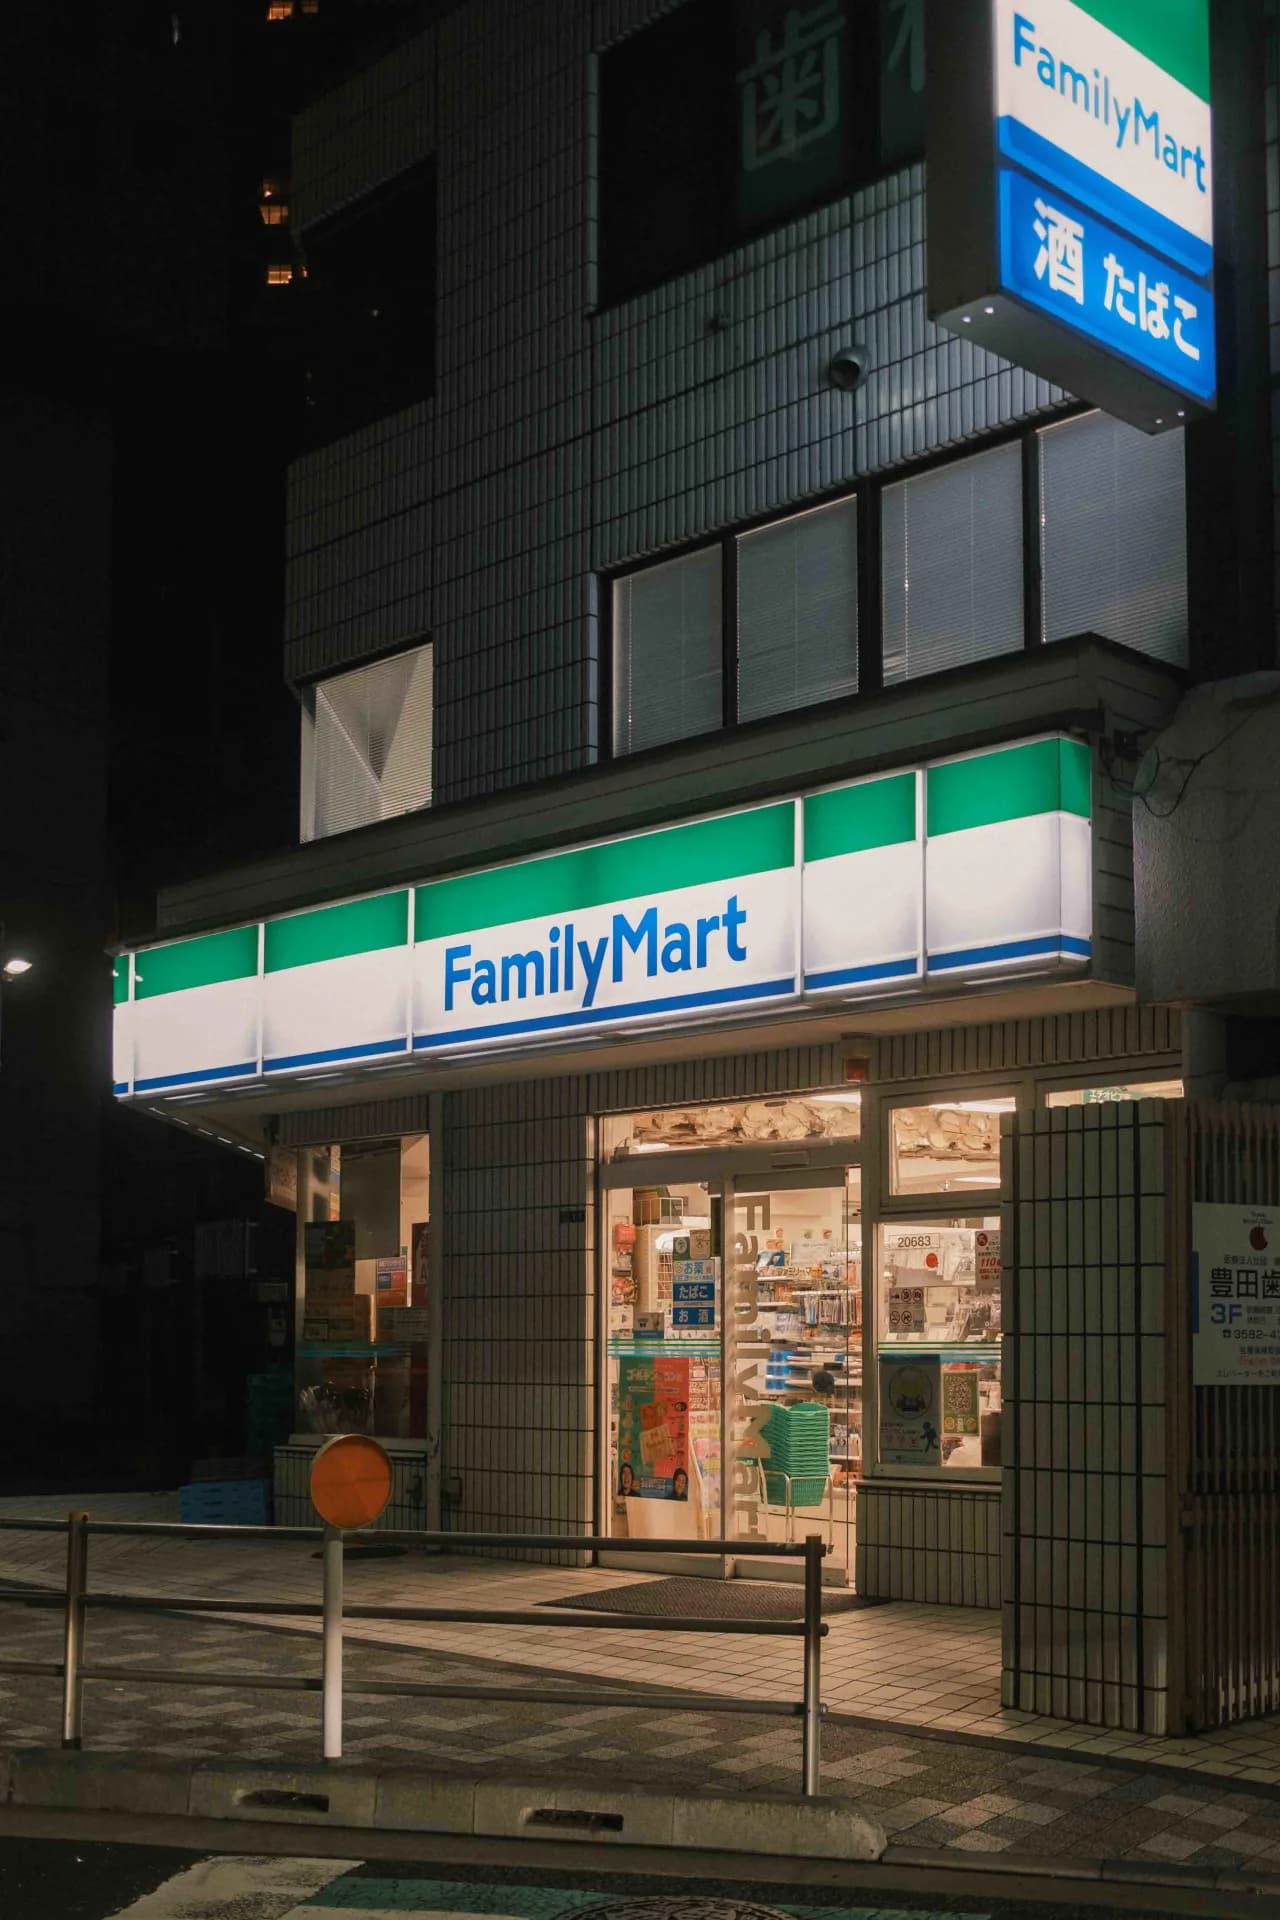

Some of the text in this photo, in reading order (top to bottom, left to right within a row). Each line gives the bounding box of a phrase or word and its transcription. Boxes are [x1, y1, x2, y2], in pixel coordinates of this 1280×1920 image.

[1013, 14, 1206, 193] FamilyMart
[1032, 198, 1201, 362] 酒 たばこ
[444, 895, 747, 1011] FamilyMart
[897, 1235, 931, 1248] 20683
[678, 1285, 709, 1300] たばこ
[1210, 1267, 1280, 1300] 豊田歯
[1210, 1303, 1243, 1325] 3F
